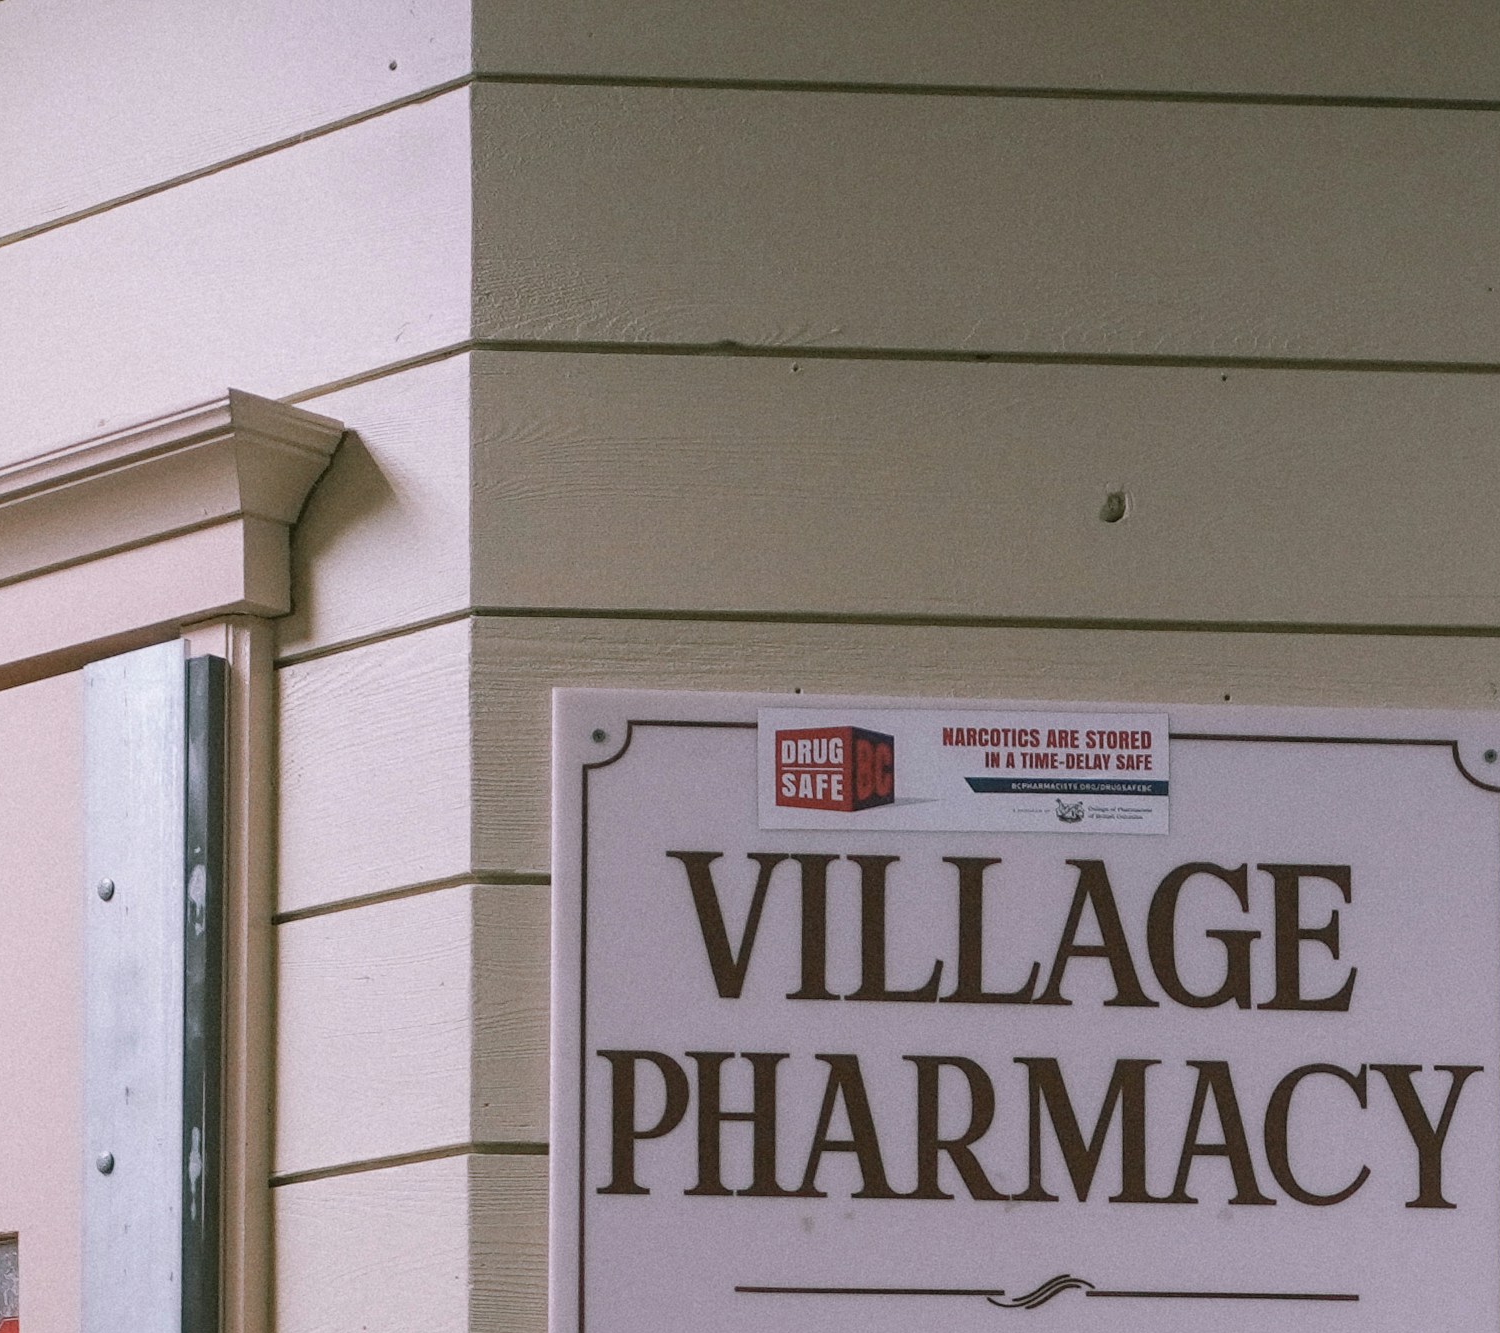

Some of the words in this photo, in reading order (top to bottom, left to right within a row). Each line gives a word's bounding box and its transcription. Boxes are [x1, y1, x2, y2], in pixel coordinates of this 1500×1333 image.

[781, 737, 844, 764] DRUG
[942, 727, 1040, 748] NARCOTICS
[1046, 729, 1080, 749] ARE
[1085, 730, 1152, 750] STORED
[856, 739, 892, 800] BC
[985, 752, 999, 769] IN
[1005, 752, 1015, 769] A
[1021, 752, 1110, 770] TIME-DELAY
[1116, 754, 1152, 770] SAFE
[781, 773, 844, 801] SAFE
[665, 850, 1358, 1011] VILLAGE
[596, 1049, 1485, 1210] PHARMACY
